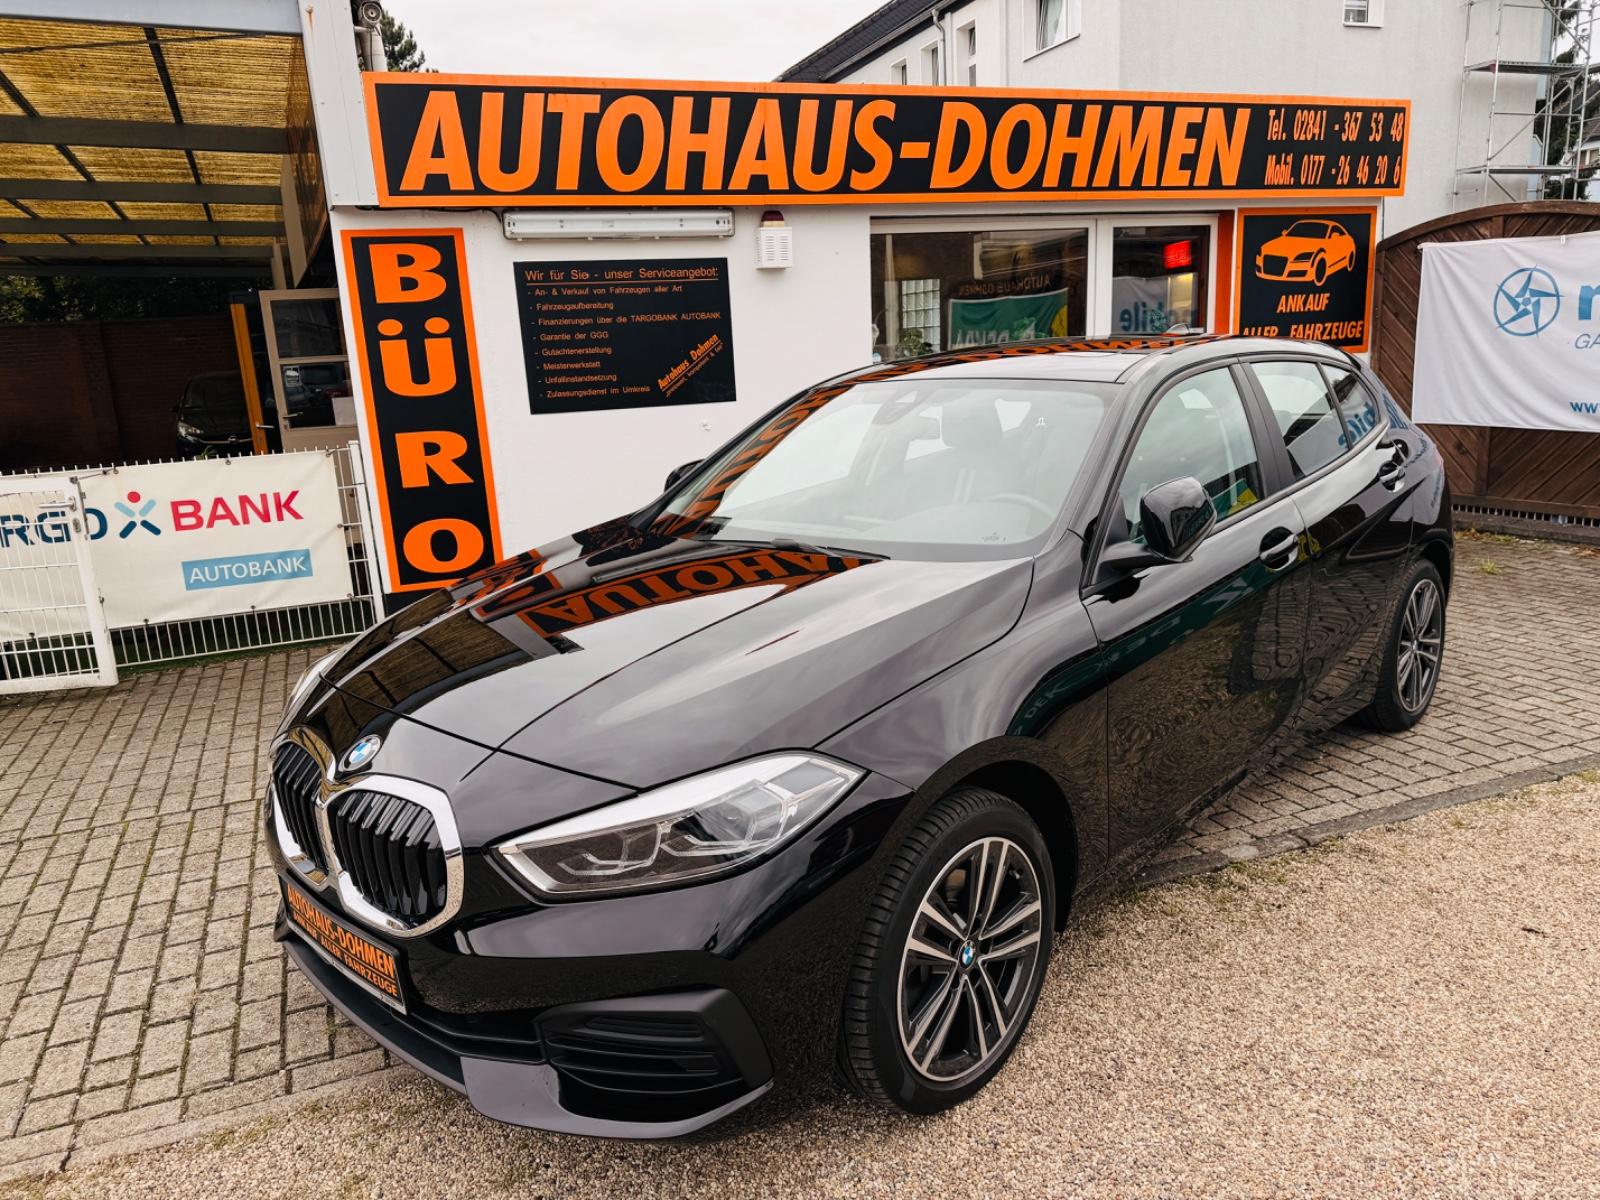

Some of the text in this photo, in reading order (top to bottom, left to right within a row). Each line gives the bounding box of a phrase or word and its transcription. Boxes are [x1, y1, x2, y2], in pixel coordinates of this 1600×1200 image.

[1267, 107, 1286, 141] Tel.
[1293, 109, 1327, 141] 02841
[1369, 112, 1384, 142] 53
[1390, 112, 1405, 142] 48
[399, 90, 1252, 193] AUTOHAUS-DOHMEN
[1264, 153, 1294, 186] Mobil.
[1300, 154, 1326, 185] 0177
[1356, 155, 1370, 185] 46
[1374, 155, 1388, 185] 20
[1393, 155, 1401, 185] 6
[525, 270, 543, 281] Wir
[549, 269, 565, 281] für
[570, 269, 590, 280] Sie
[604, 269, 634, 280] unser
[639, 267, 719, 281] Serviceangebot:
[534, 288, 548, 296] An-
[552, 288, 559, 296] &
[561, 286, 590, 296] Verkauf
[593, 287, 606, 295] von
[609, 286, 651, 296] Fahrzeugen
[672, 285, 683, 293] Art
[1276, 293, 1331, 314] ANKAUF
[538, 317, 594, 327] Finanzierungen
[597, 316, 614, 325] über
[630, 314, 678, 323] TARGOBANK
[681, 312, 721, 321] AUTOBANK
[540, 333, 571, 342] Garantie
[574, 332, 586, 340] der
[1290, 320, 1364, 341] FAHRZEUGE
[543, 361, 601, 370] Meisterwerkstatt
[658, 334, 719, 389] Autohaus Dohmen
[622, 385, 651, 394] Umkreis
[368, 243, 484, 574] BÜRO
[1570, 402, 1600, 414] ww
[170, 490, 304, 532] BANK
[189, 556, 307, 584] AUTOBANK
[344, 954, 398, 997] FAHRZEUGE
